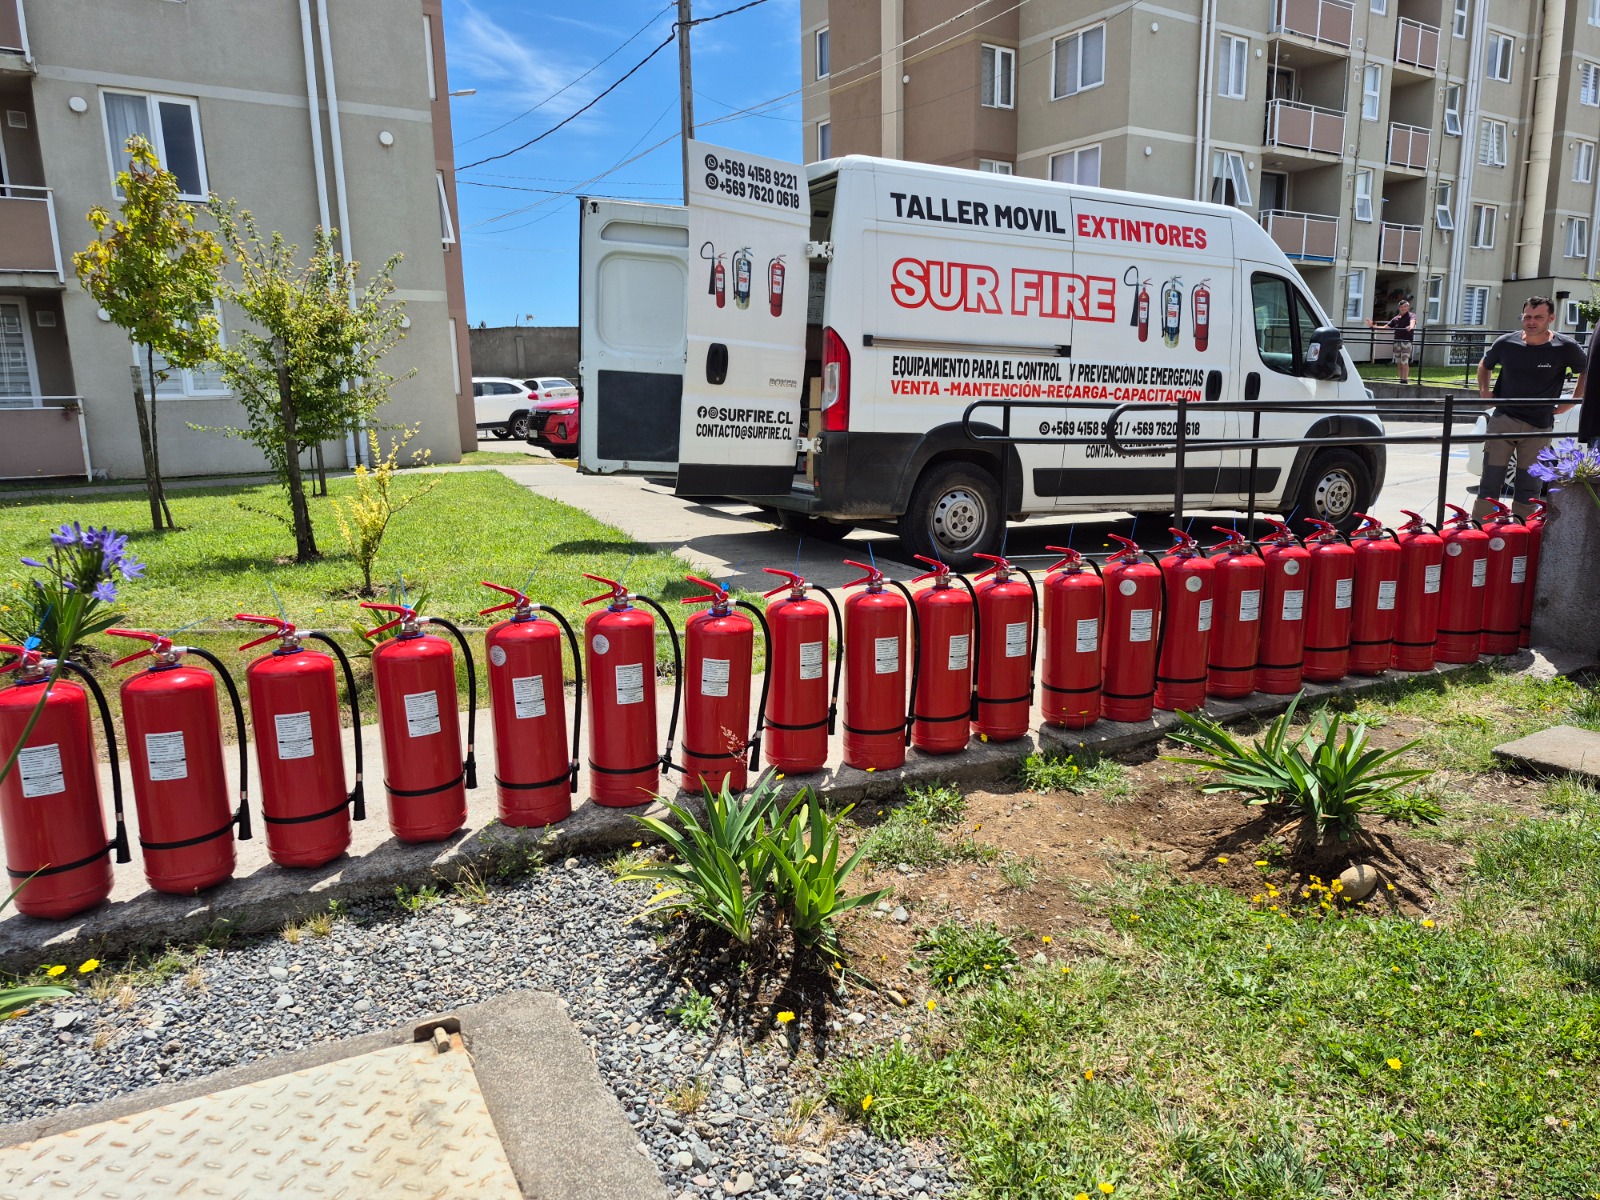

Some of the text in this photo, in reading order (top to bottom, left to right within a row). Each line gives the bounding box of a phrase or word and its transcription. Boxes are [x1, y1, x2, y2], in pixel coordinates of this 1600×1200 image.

[719, 158, 798, 190] +569 4158 9221
[720, 178, 800, 209] +569 7620 0618
[890, 192, 1207, 250] TALLER MOVIL EXTINTORES
[890, 257, 1003, 315] SUR
[1011, 267, 1116, 323] FIRE
[892, 355, 970, 378] EQUIPAMIENTO
[972, 358, 999, 379] PARA
[1002, 360, 1014, 380] EL
[1017, 361, 1062, 382] CONTROL
[1069, 363, 1076, 382] Y
[1137, 366, 1149, 385] DE
[1150, 367, 1204, 387] EMERGECIAS
[890, 379, 940, 396] VENTA
[696, 423, 792, 441] CONTACTO@SURFIRE.CL
[719, 408, 794, 425] SURFIRE.CL
[1051, 421, 1075, 436] +569
[1077, 421, 1099, 436] 4158
[1100, 421, 1123, 436] 921
[1124, 421, 1131, 436] /
[1131, 421, 1154, 436] +569
[1155, 421, 1178, 436] 7620
